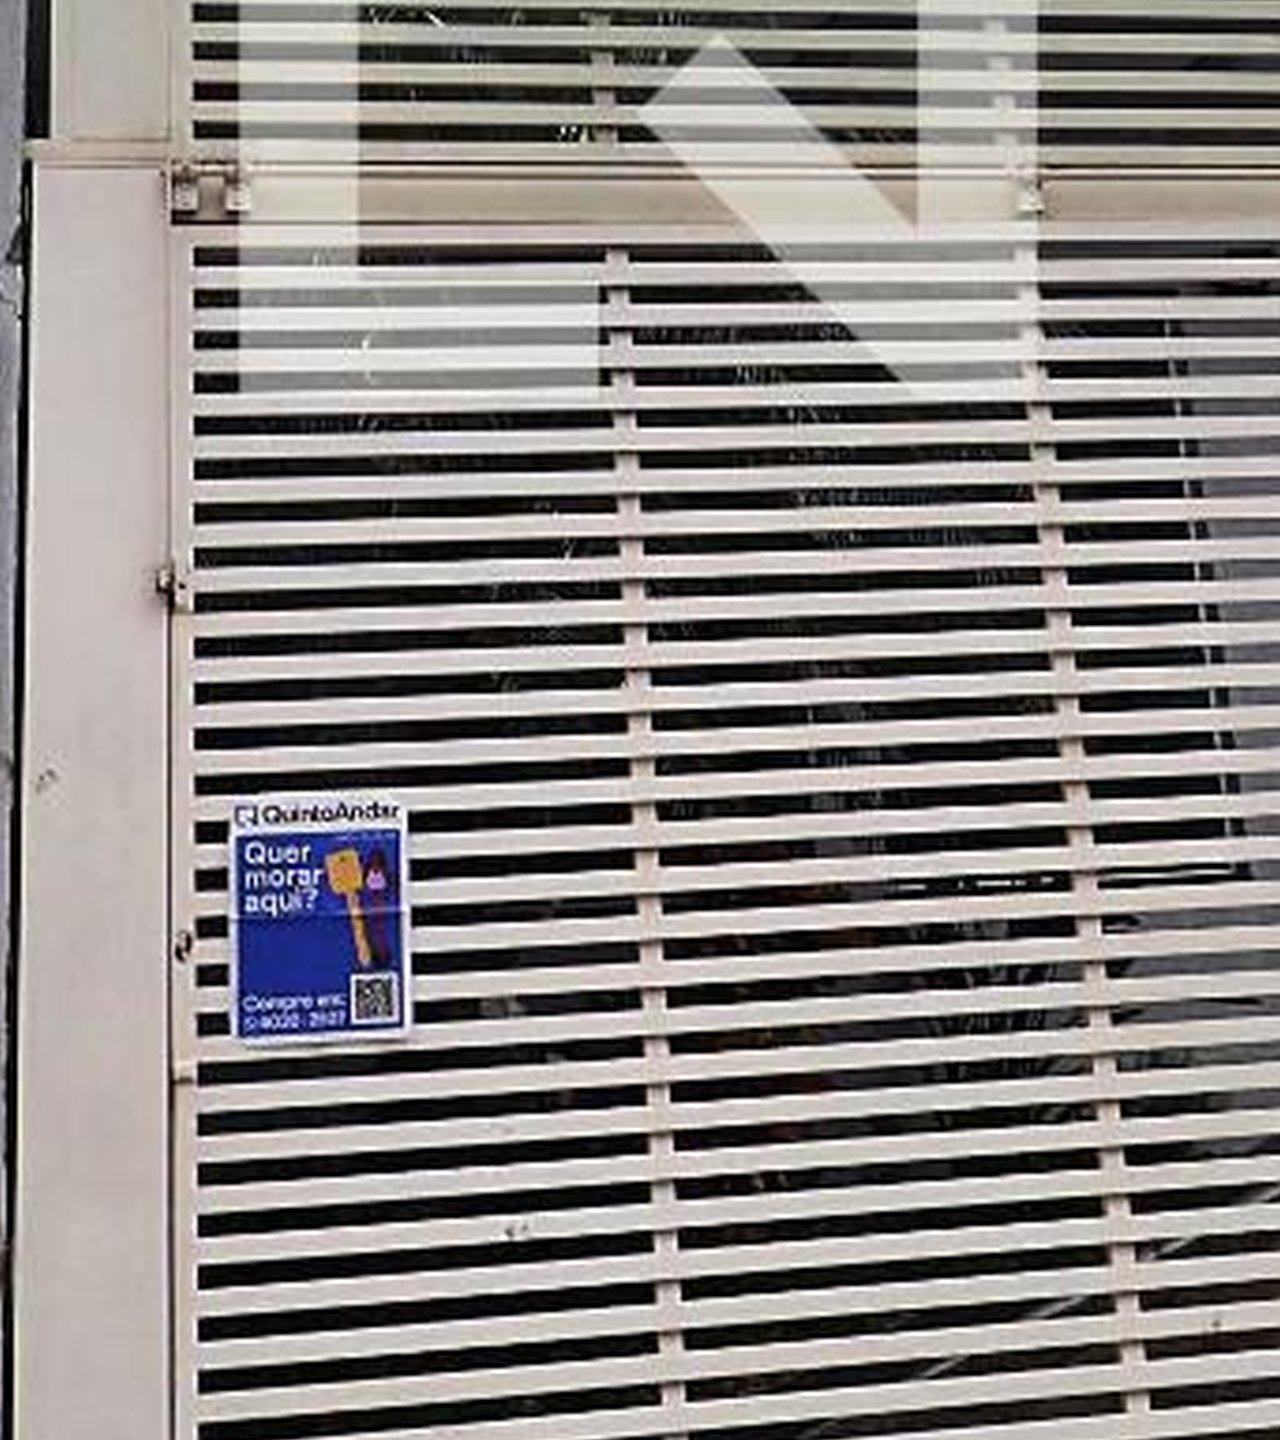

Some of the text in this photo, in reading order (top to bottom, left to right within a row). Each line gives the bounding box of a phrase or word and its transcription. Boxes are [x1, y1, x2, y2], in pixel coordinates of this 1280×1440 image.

[261, 801, 401, 823] QuintoAndar
[244, 840, 312, 866] Quer
[244, 868, 324, 890] morar
[244, 888, 319, 917] aqui?
